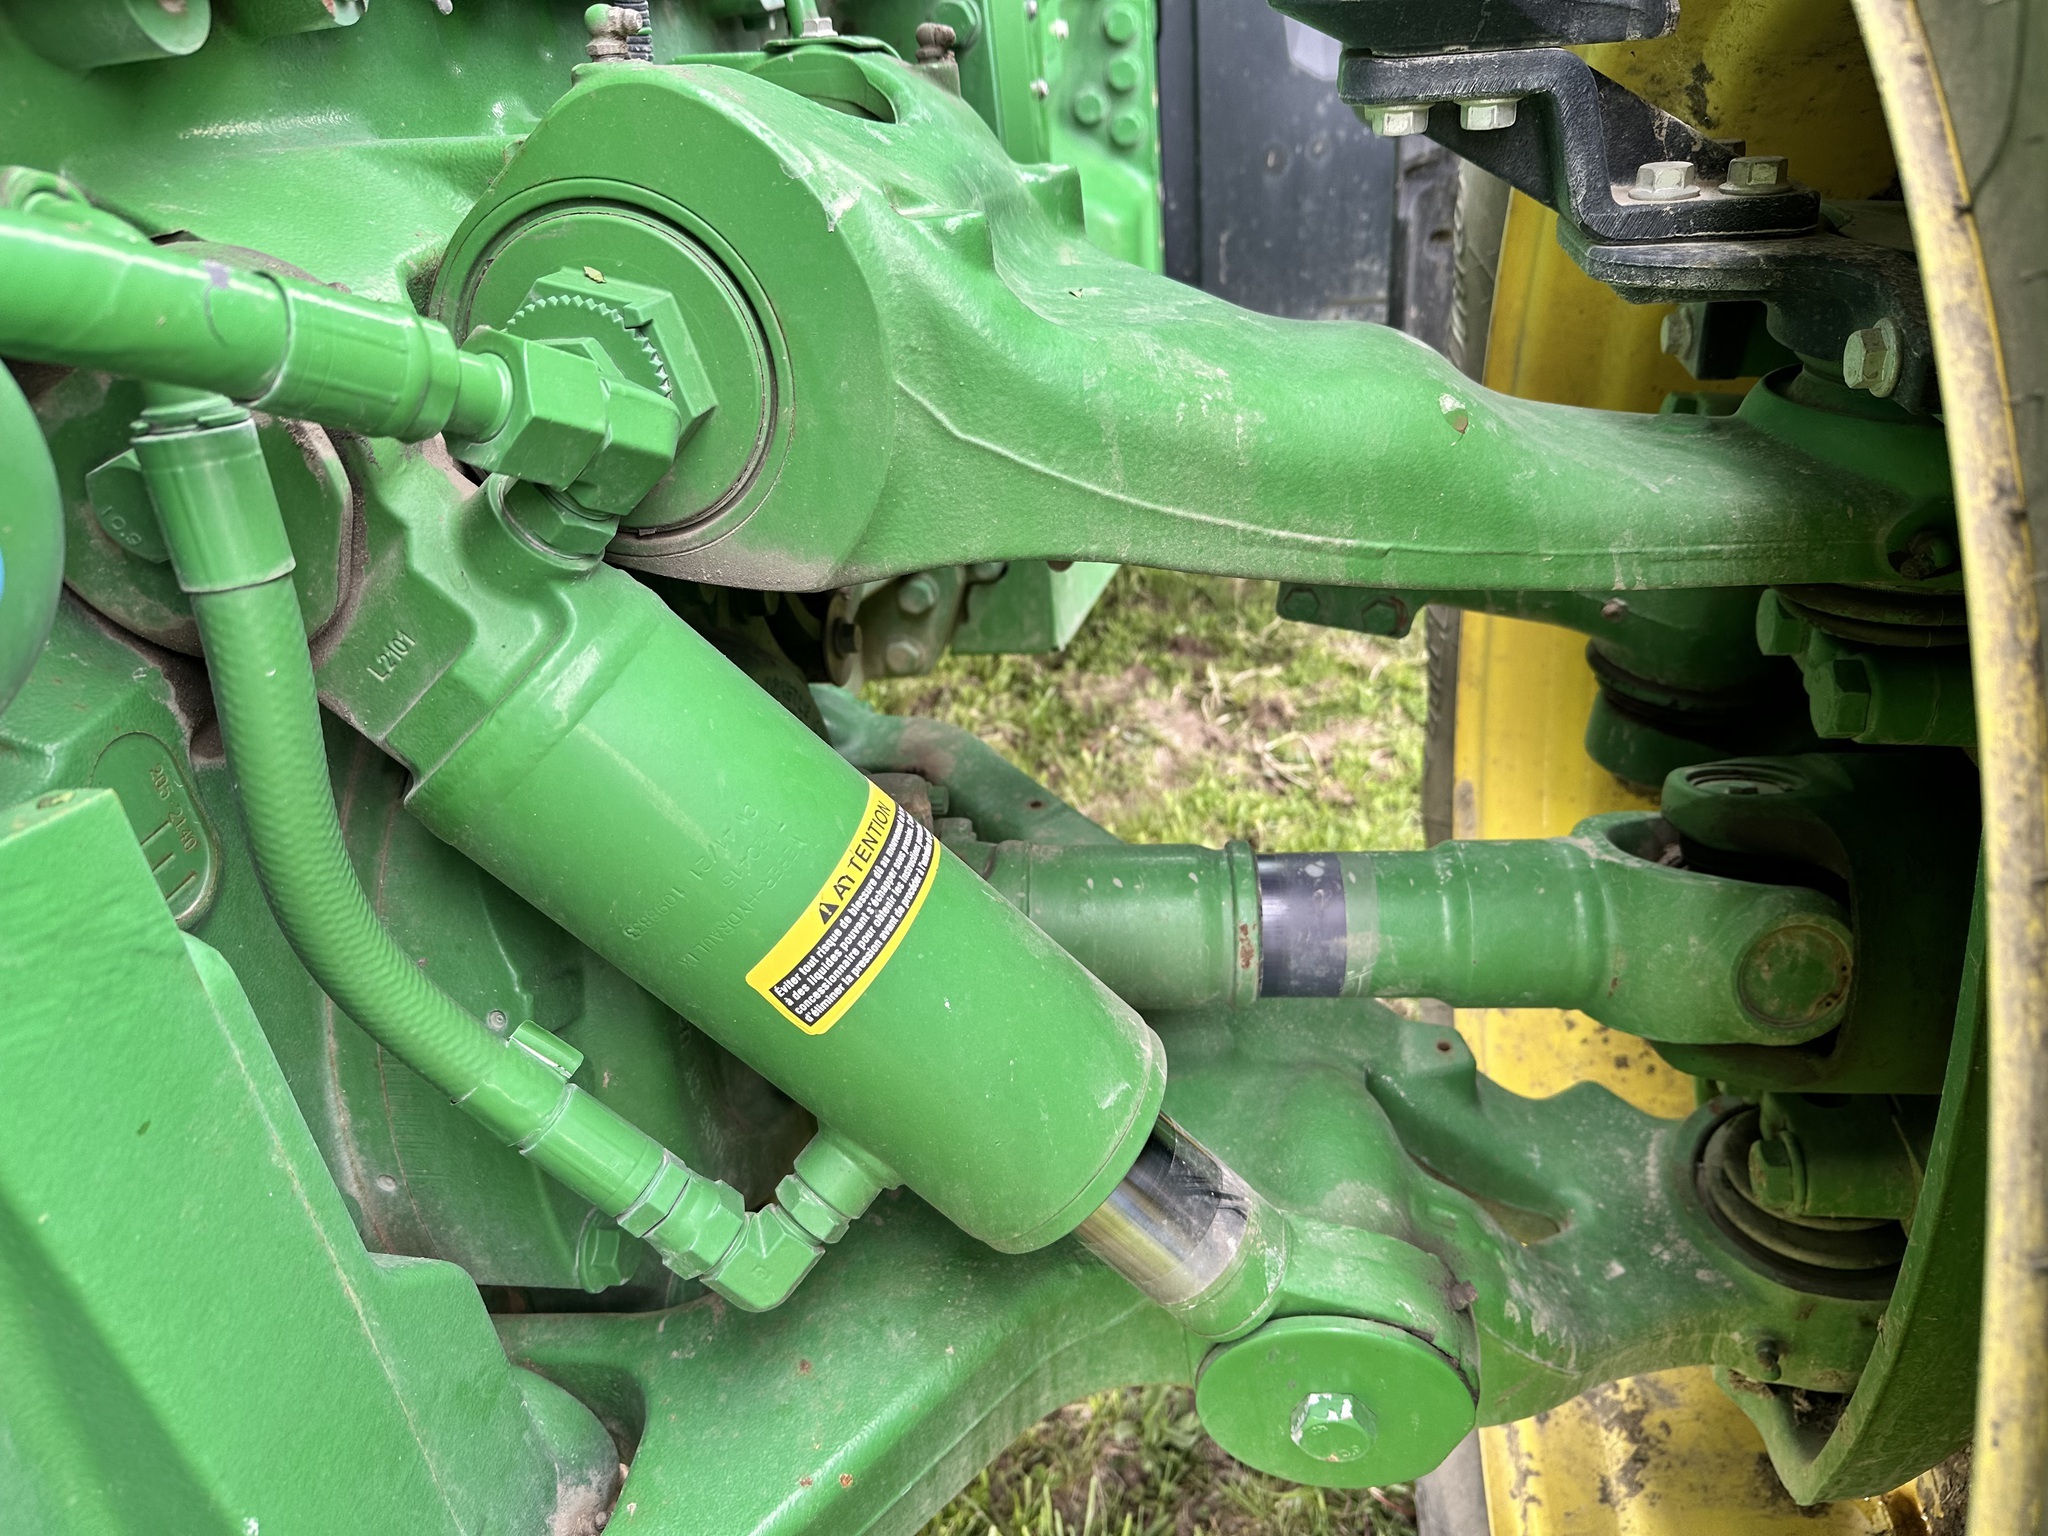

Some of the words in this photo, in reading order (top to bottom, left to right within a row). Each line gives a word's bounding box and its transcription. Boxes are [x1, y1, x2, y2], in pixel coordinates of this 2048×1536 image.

[101, 505, 143, 547] 10.9
[366, 629, 417, 683] L2101
[836, 800, 891, 902] ATTENTION
[773, 972, 802, 998] Éviter
[798, 954, 820, 976] tout
[815, 927, 843, 959] risque
[839, 915, 853, 930] de
[846, 877, 878, 917] blessure
[872, 864, 885, 880] dû
[879, 854, 891, 869] au
[783, 997, 795, 1007] à
[791, 983, 811, 1001] des
[806, 948, 843, 986] liquides
[839, 911, 871, 953] pouvant
[892, 850, 907, 871] sous
[794, 947, 861, 1015] concessionnaire
[856, 925, 877, 951] pour
[872, 893, 897, 928] obtenir
[890, 881, 905, 897] les
[898, 843, 921, 884] instructions
[840, 974, 855, 986] la
[850, 938, 884, 978] pression
[878, 914, 900, 942] avant
[893, 904, 906, 919] de
[900, 872, 923, 909] procéder
[915, 867, 925, 877] à
